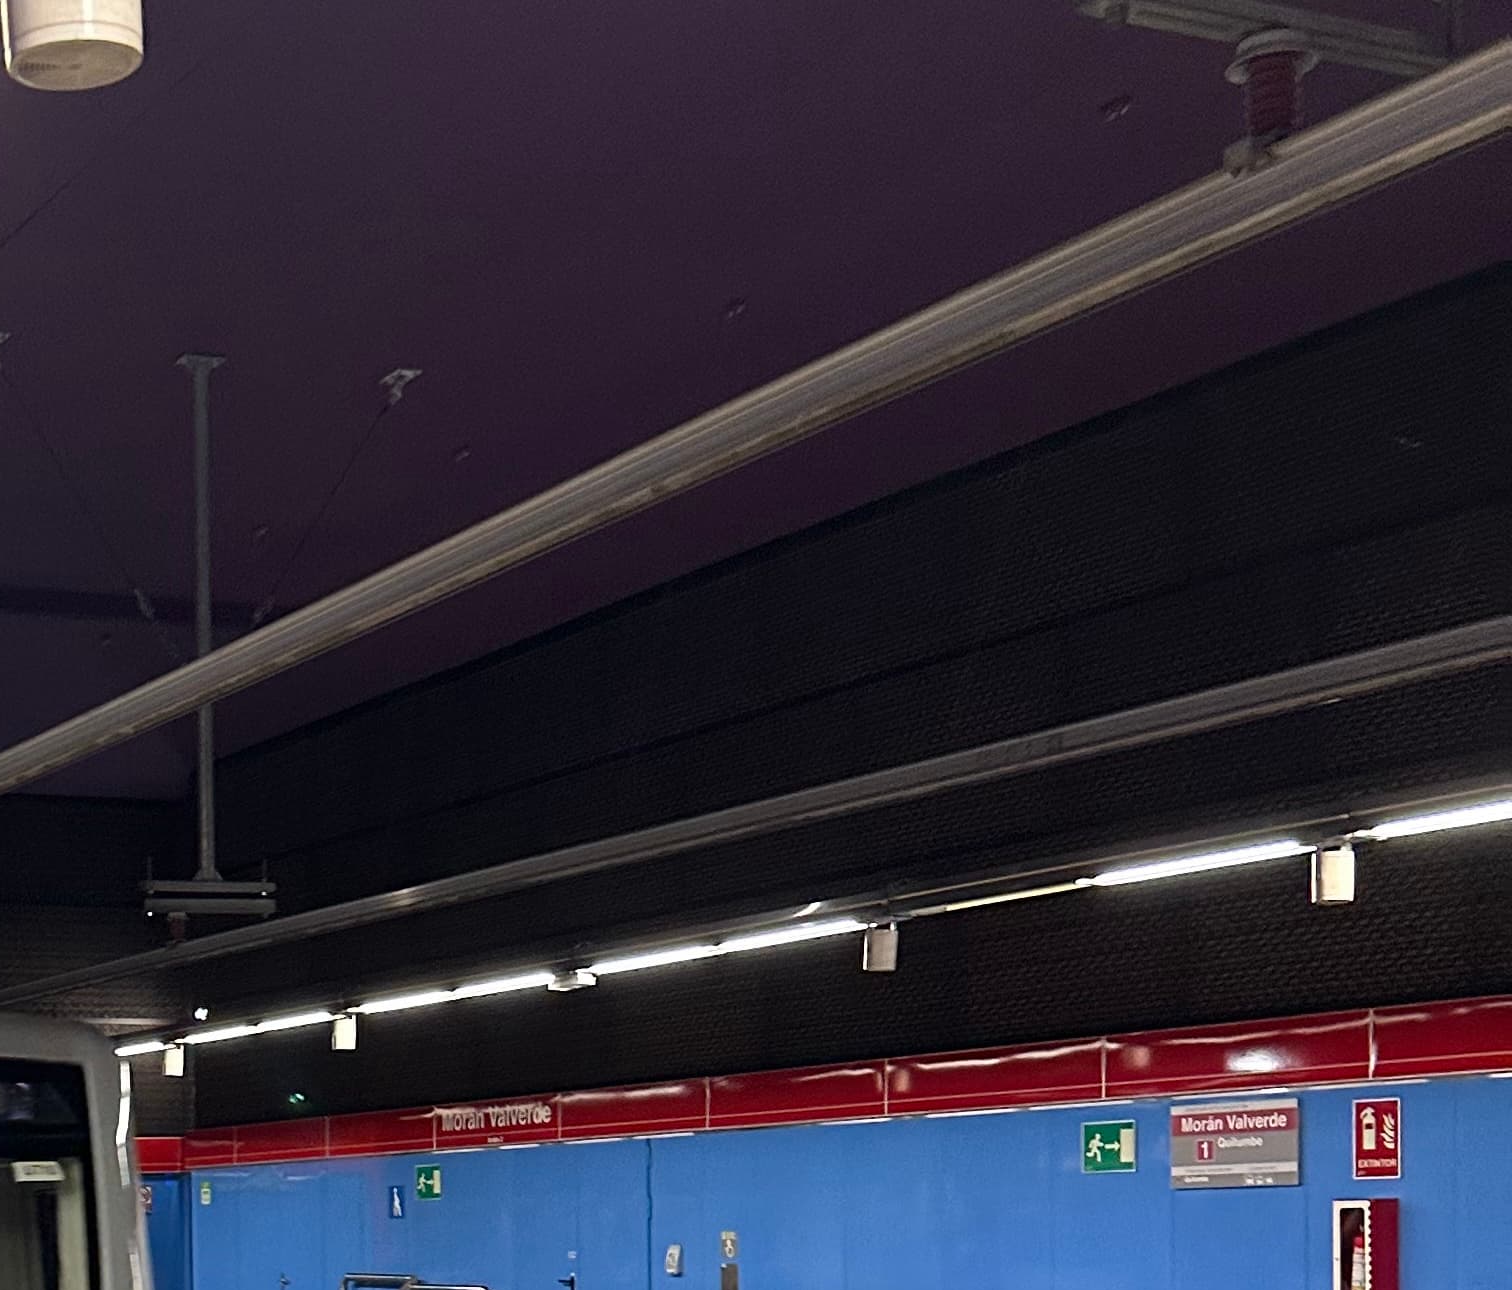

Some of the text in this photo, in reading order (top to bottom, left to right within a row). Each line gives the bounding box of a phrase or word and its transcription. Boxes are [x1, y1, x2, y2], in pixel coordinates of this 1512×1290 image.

[488, 1102, 553, 1128] Valverde
[1181, 1112, 1288, 1133] Morán Valverde
[1200, 1141, 1209, 1159] 1
[1357, 1158, 1397, 1169] EXTINTOR
